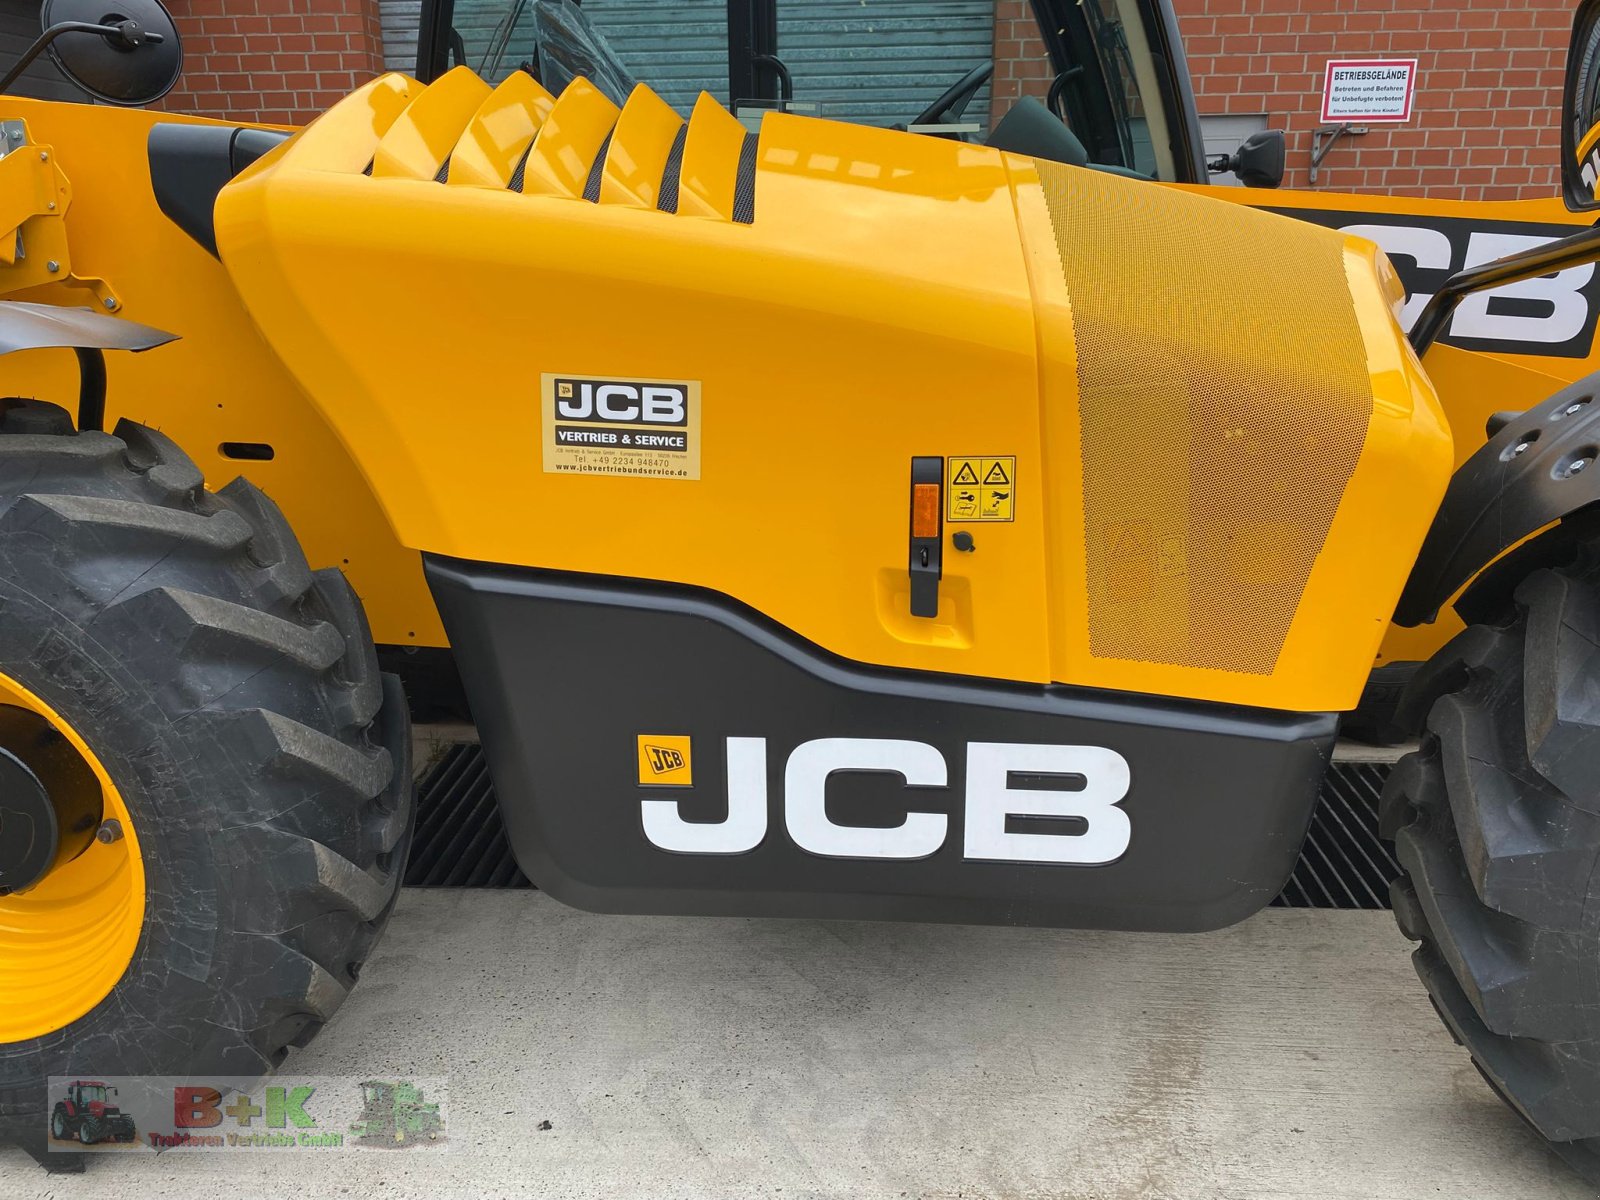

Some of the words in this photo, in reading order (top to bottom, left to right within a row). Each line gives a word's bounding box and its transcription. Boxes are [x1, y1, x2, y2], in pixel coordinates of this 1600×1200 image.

[1334, 69, 1407, 80] BETRIEBSGELÄNDE
[558, 384, 684, 422] JCB
[558, 431, 617, 444] VERTRIEB
[621, 434, 631, 445] &
[635, 434, 684, 447] SERVICE
[593, 456, 610, 464] +49
[613, 457, 634, 465] 2234
[637, 458, 669, 467] 948470
[555, 464, 688, 476] www.jcbvertriebundservice.de
[652, 748, 682, 771] JCB
[641, 736, 1131, 865] JCB
